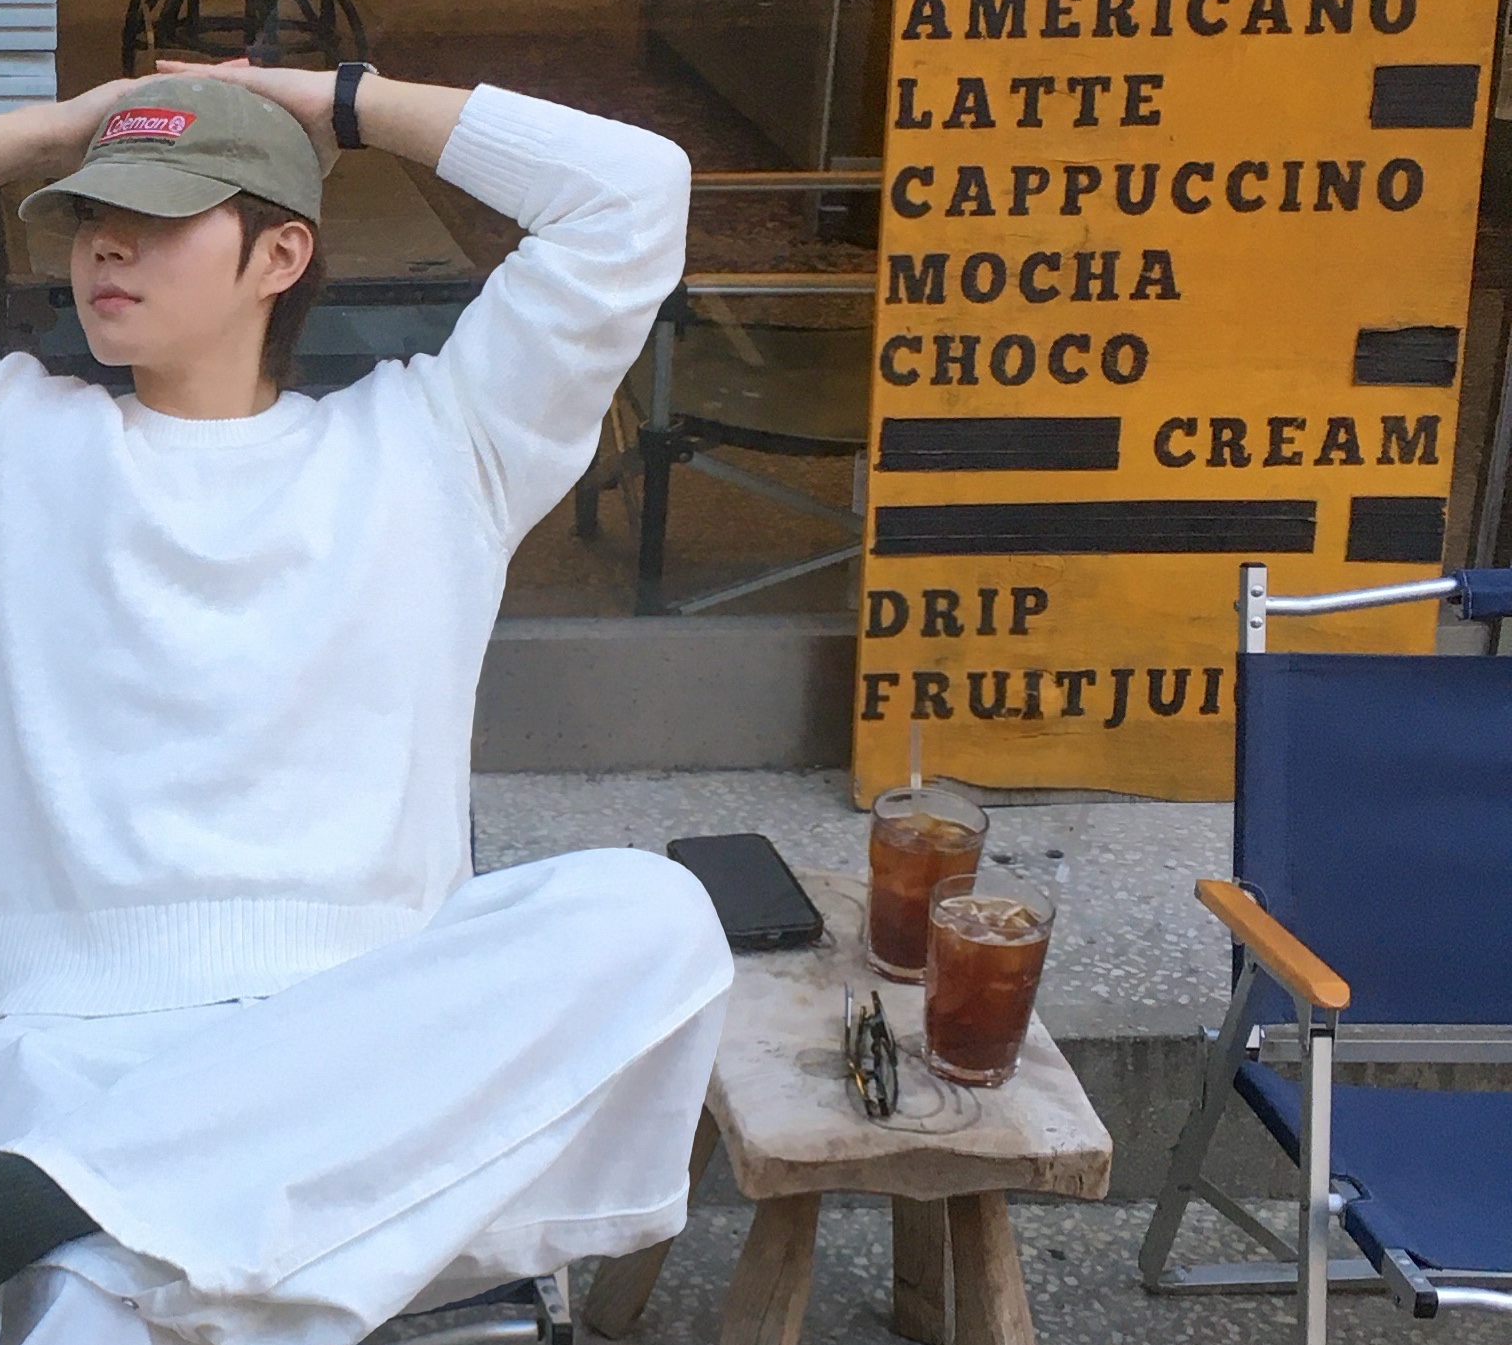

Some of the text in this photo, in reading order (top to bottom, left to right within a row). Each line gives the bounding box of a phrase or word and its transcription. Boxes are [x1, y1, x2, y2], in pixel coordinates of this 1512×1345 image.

[106, 112, 169, 136] Coleman
[894, 74, 1164, 130] LATTE
[890, 157, 1424, 219] CAPPUCCINO
[885, 249, 1182, 305] MOCHA
[879, 332, 1149, 387] CHOCO
[1154, 414, 1441, 468] CREAM
[864, 586, 1049, 639] DRIP
[860, 667, 1238, 730] FRUITJUI
